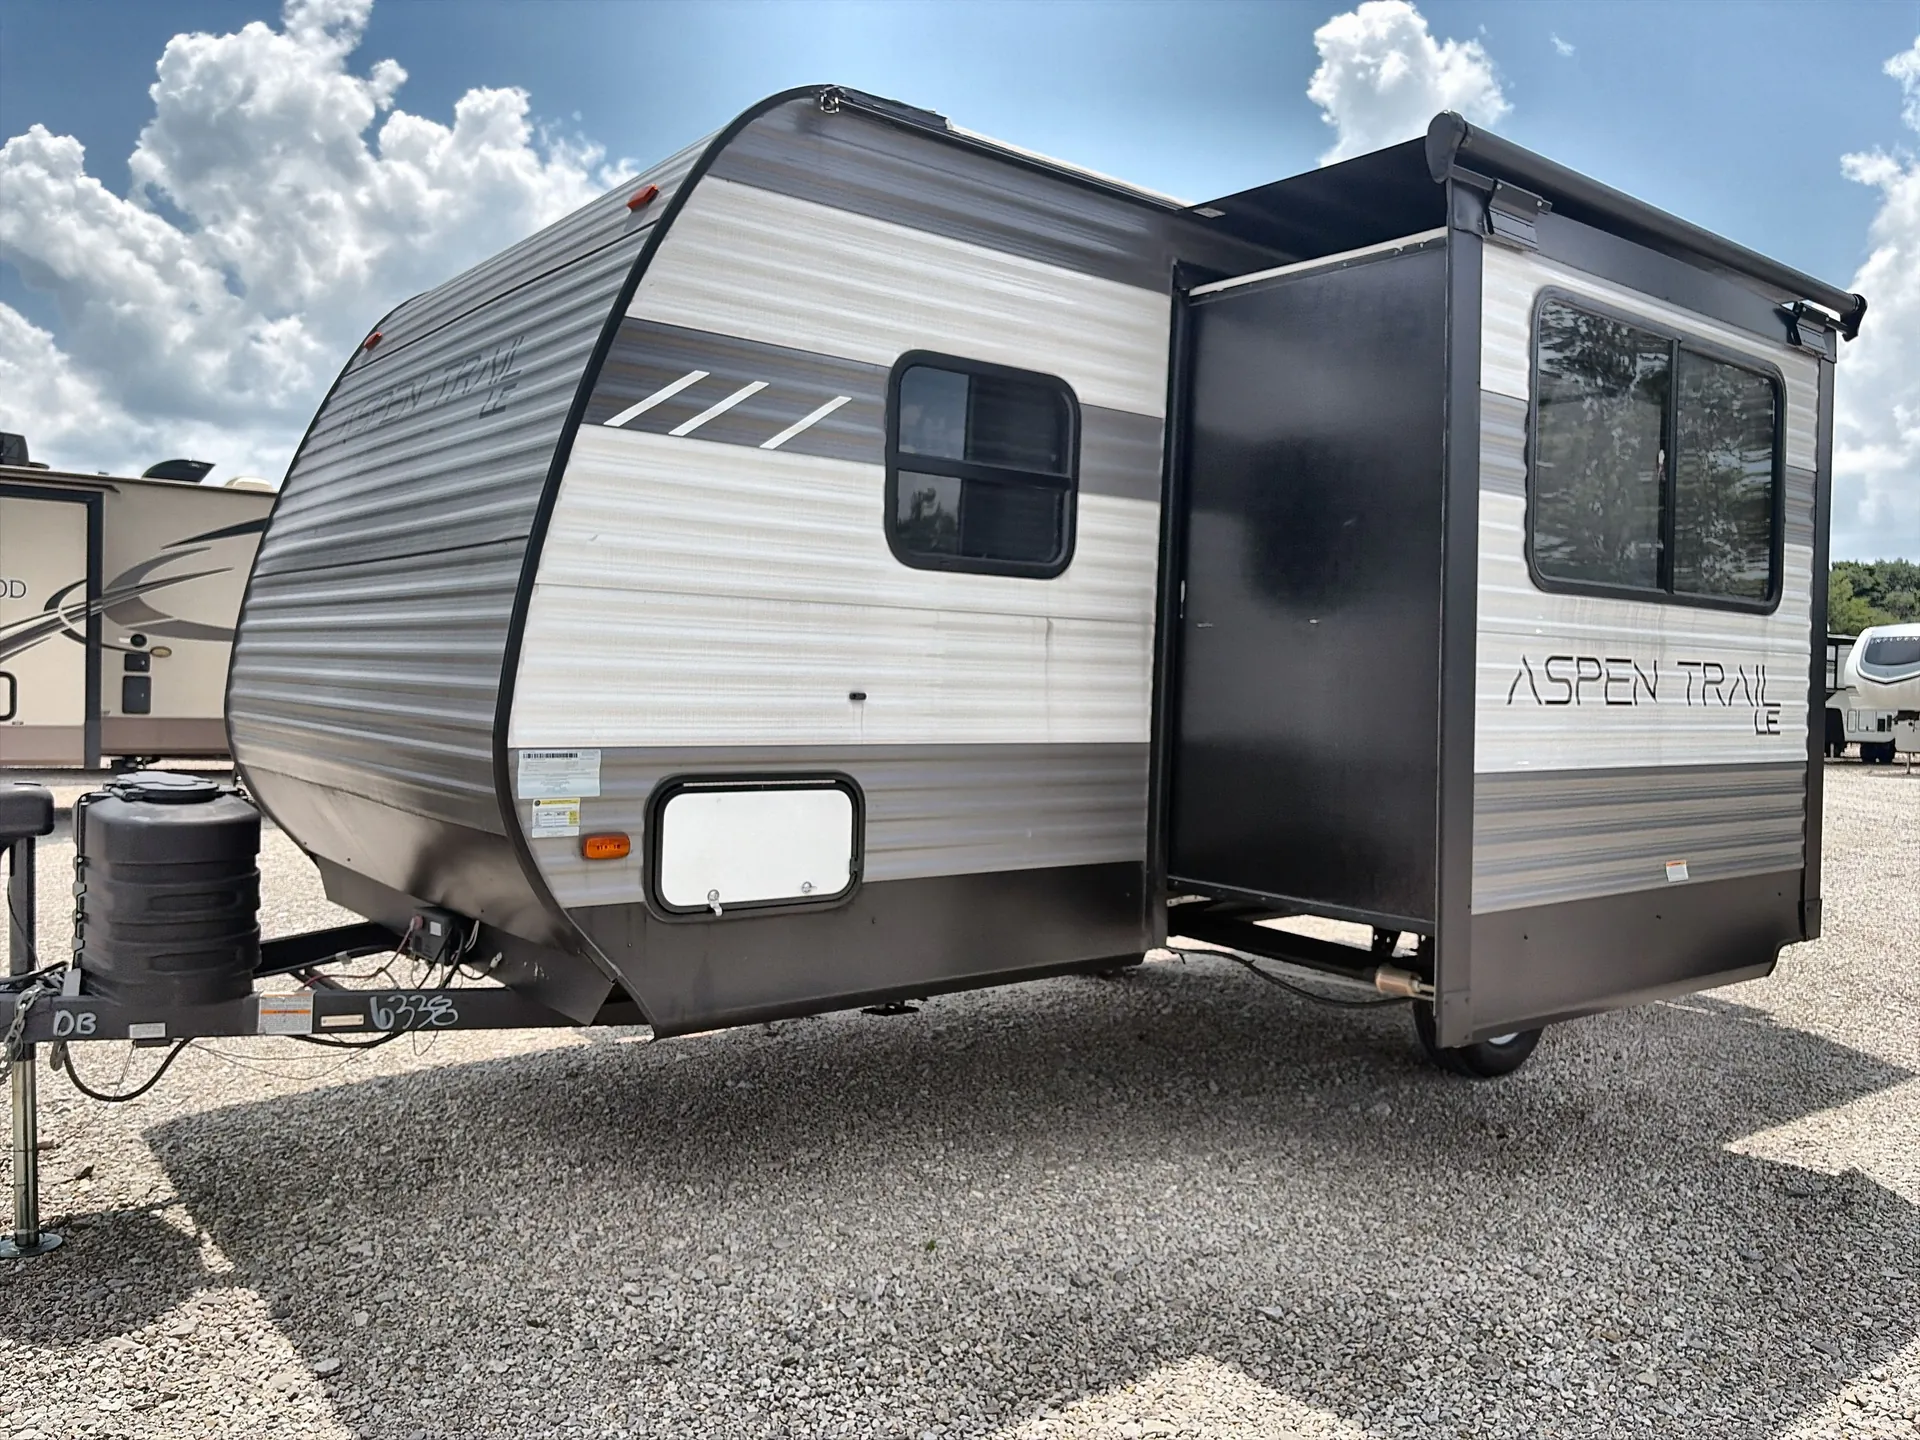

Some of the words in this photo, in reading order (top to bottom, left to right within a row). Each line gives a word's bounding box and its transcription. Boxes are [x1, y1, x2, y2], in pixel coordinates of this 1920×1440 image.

[478, 382, 519, 419] LE
[1507, 654, 1658, 705] ASPEN
[1677, 661, 1781, 707] TRAIL
[1754, 709, 1781, 735] LE
[53, 1009, 97, 1036] DB
[370, 995, 459, 1030] 6338
